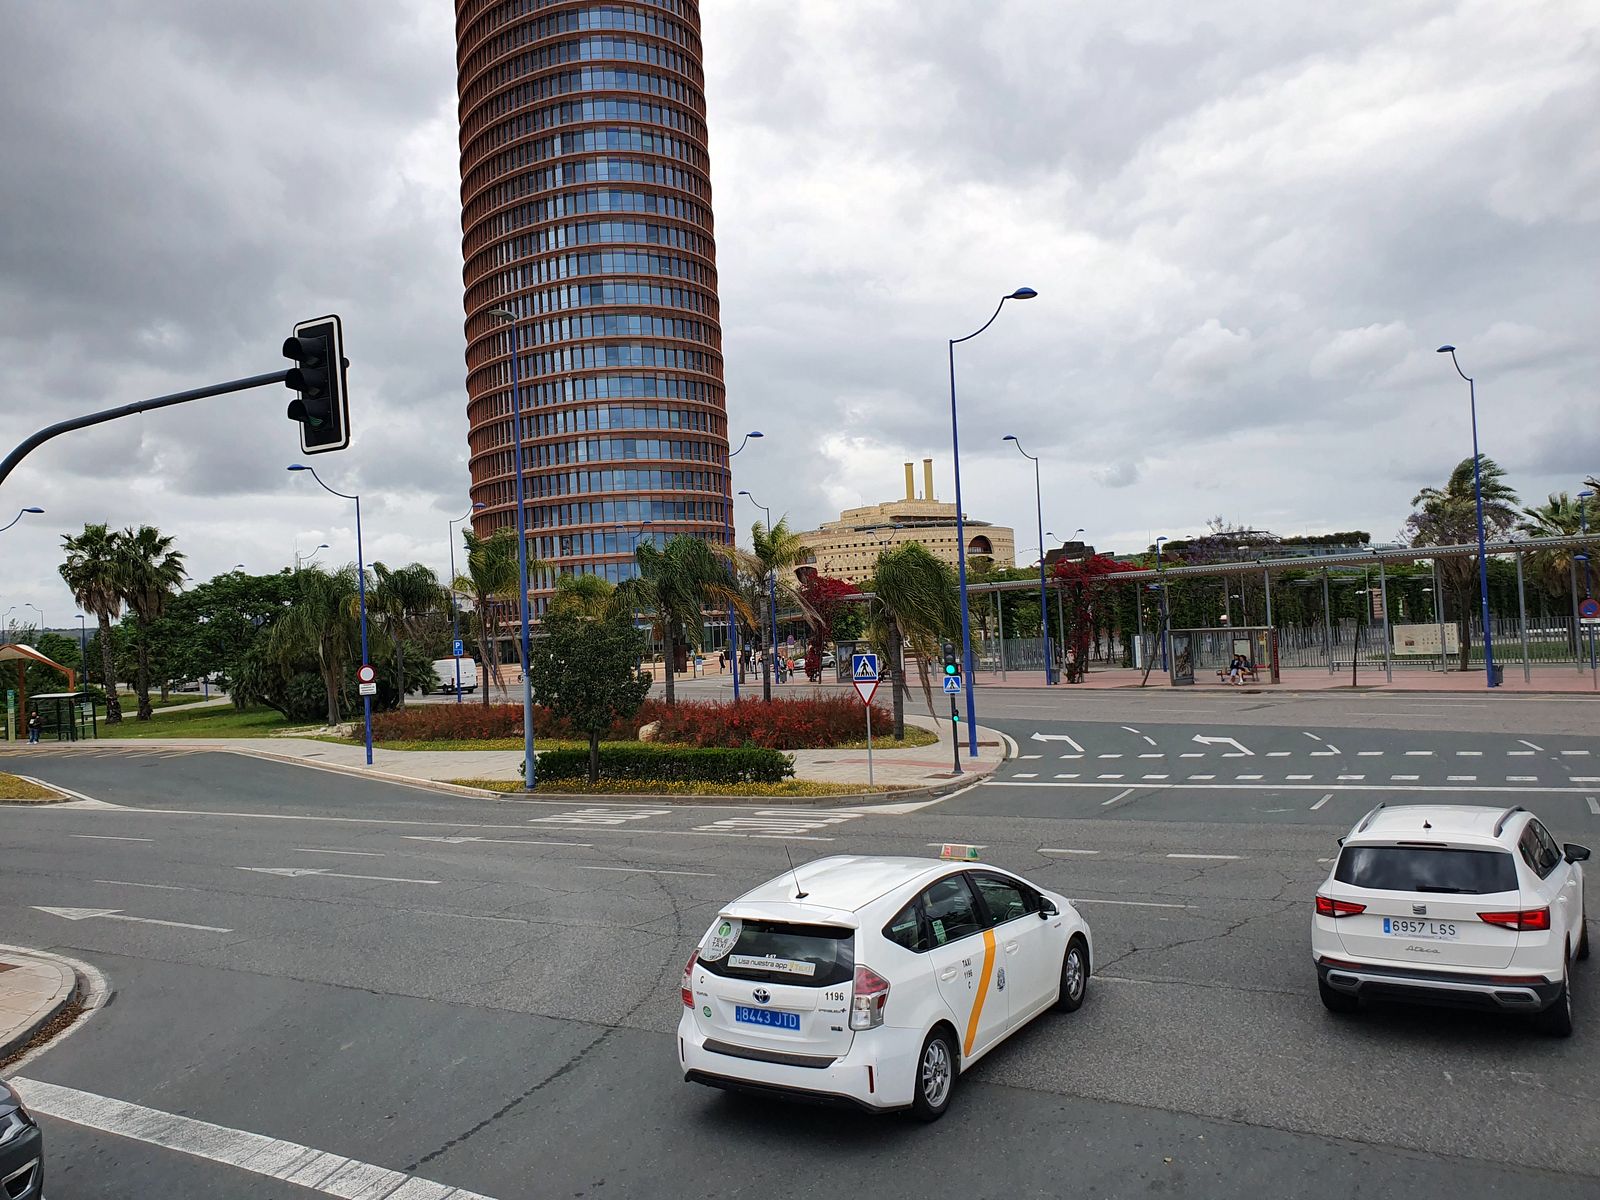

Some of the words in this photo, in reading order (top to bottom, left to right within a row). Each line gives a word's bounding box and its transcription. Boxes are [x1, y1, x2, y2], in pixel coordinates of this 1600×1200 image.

[528, 808, 673, 825] BUS
[691, 811, 864, 834] SOLO
[1392, 920, 1425, 934] 6957
[1430, 922, 1456, 936] LSS
[712, 941, 727, 949] TAXI
[750, 960, 775, 968] nuestra
[962, 958, 972, 967] TAXI
[700, 975, 705, 984] C
[825, 991, 845, 1001] 1196
[742, 1008, 771, 1024] 8443
[774, 1012, 797, 1028] JTD
